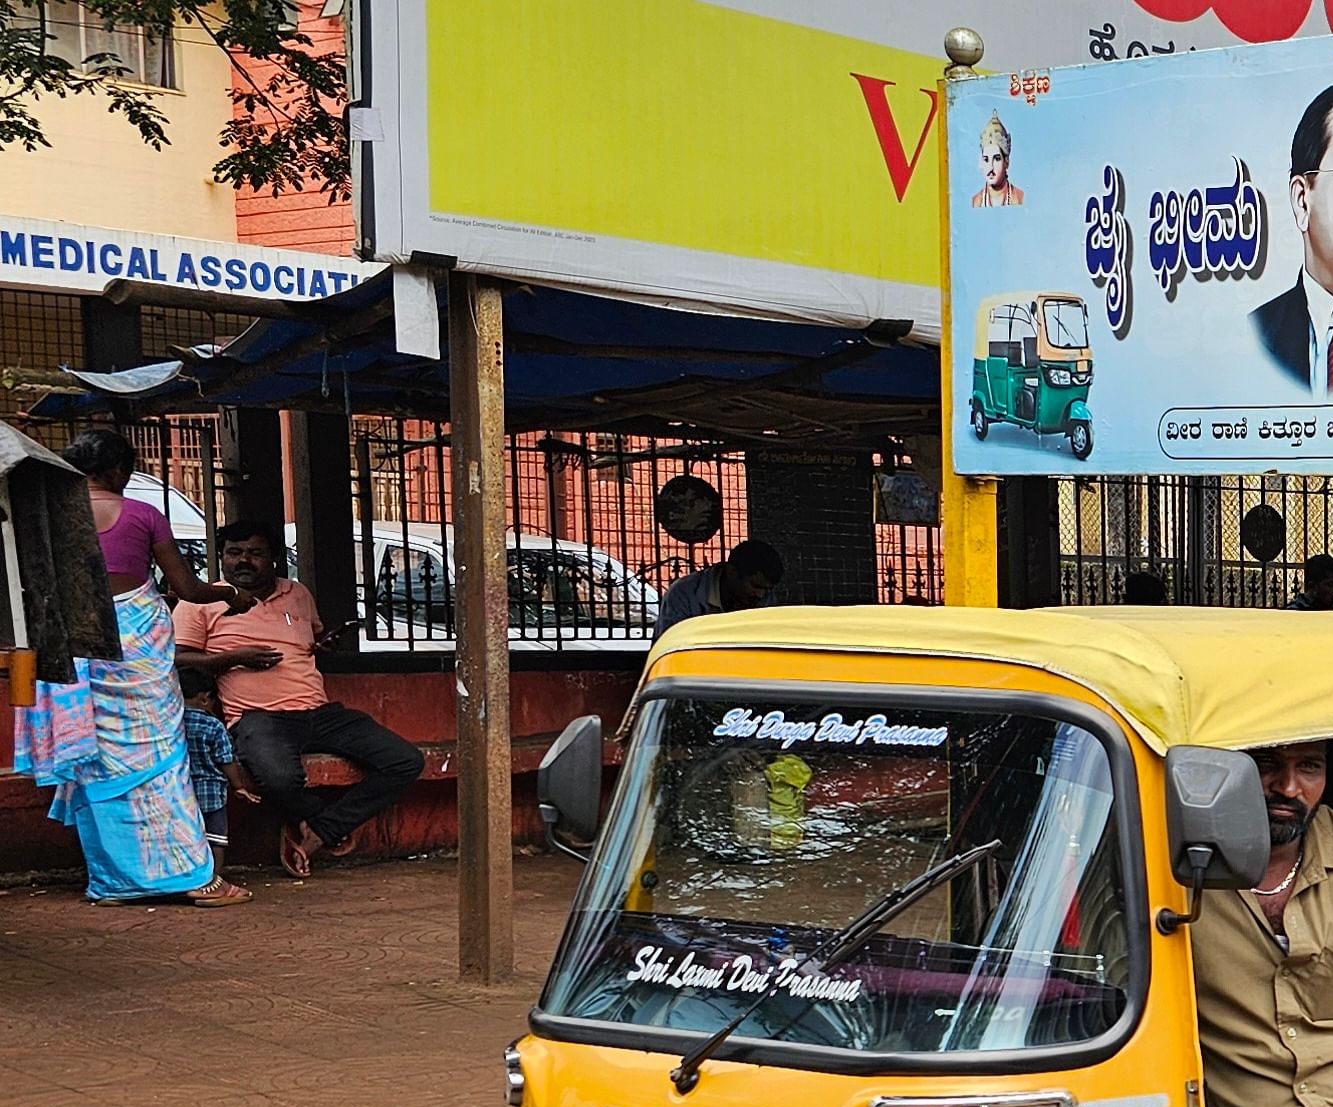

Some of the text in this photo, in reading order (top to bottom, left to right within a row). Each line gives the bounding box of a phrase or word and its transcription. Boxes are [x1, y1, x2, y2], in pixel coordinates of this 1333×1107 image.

[1010, 73, 1050, 106] ಶಿಕ್ಷಣ
[1, 231, 372, 297] MEDICAL ASSOCIATI
[1085, 163, 1129, 332] ಜೈ
[1148, 155, 1263, 294] ಭೀಮ
[1166, 417, 1202, 440] ವೀರ
[1211, 416, 1249, 441] ರಾಣಿ
[1258, 415, 1317, 447] ಕಿತ್ತೂರ
[713, 707, 948, 749] Shri Durga Devi Prasanna
[626, 945, 862, 1003] Shri Laxmi Devi Prasanna
